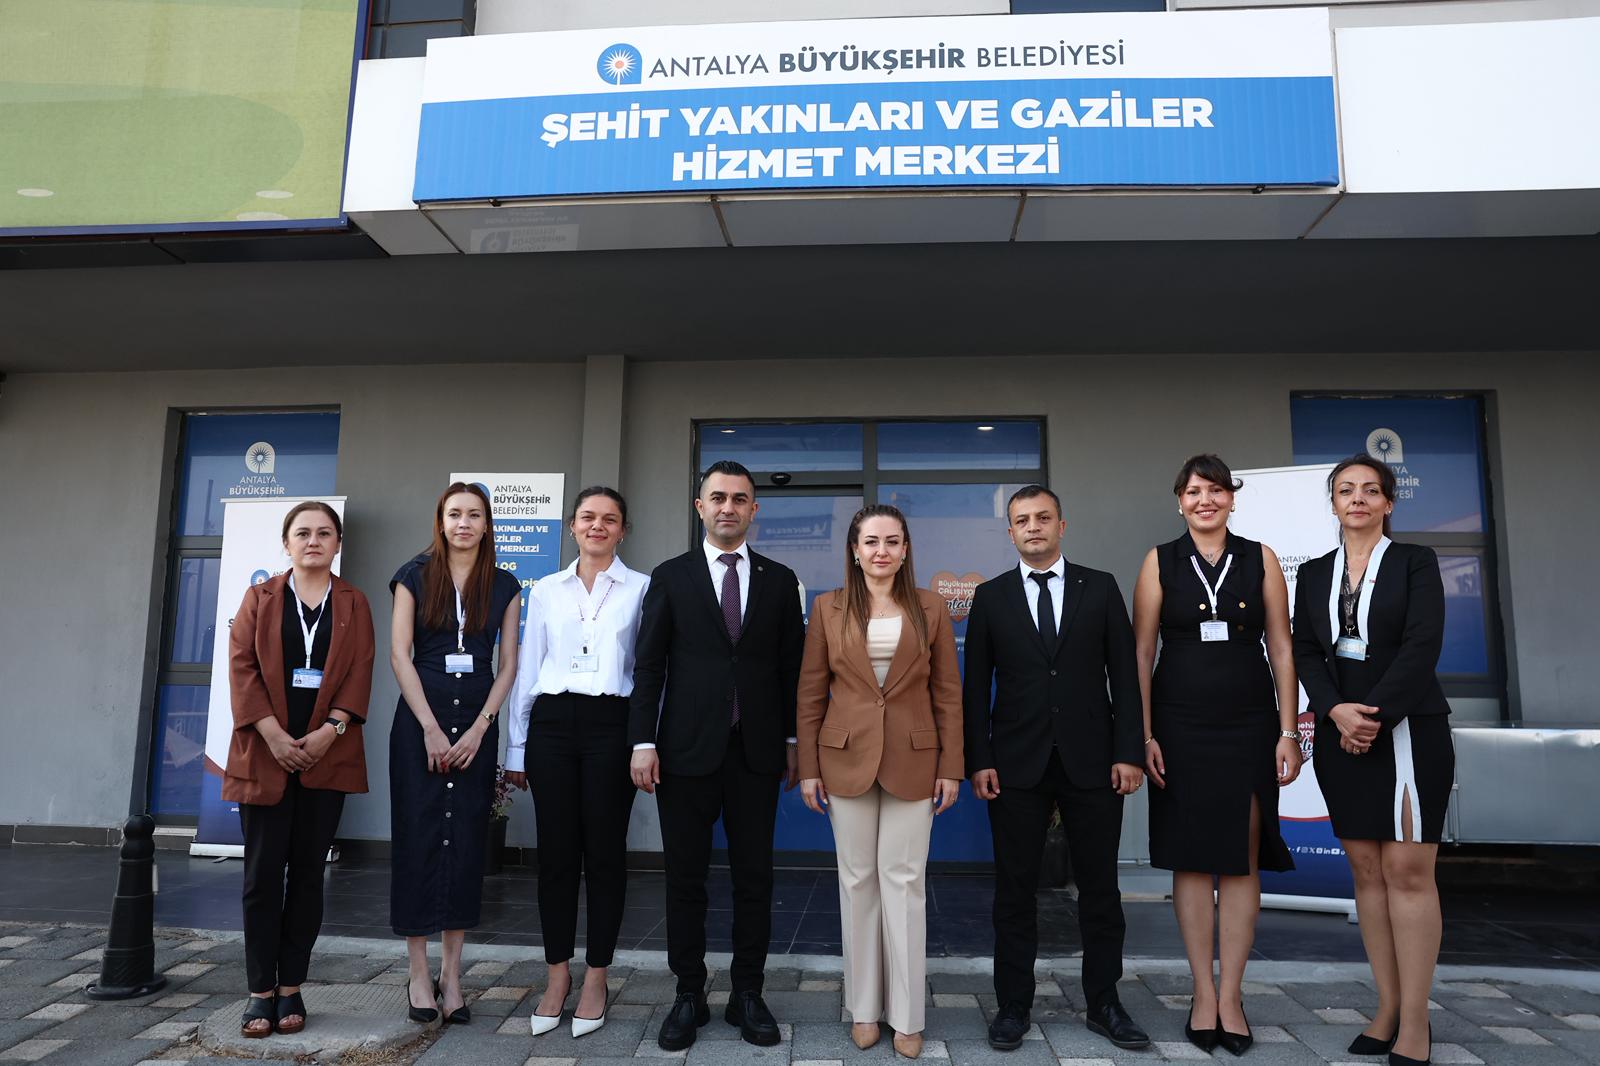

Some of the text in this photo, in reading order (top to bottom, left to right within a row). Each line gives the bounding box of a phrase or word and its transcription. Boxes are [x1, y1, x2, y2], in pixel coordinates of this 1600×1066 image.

[648, 39, 1125, 78] ANTALYA BÜYÜKŞEHİR BELEDİYESİ
[540, 91, 1215, 148] ŞEHİT YAKINLARI VE GAZİLER
[671, 136, 1061, 182] HİZMET MERKEZİ
[240, 475, 277, 484] ANTALYA
[229, 484, 285, 497] BÜYÜKŞEHİR
[494, 485, 532, 493] ANTALYA
[493, 494, 551, 505] BÜYÜKŞEHİR
[493, 505, 538, 515] BELEDİYESİ
[493, 525, 549, 533] AKINLARI VE
[494, 534, 522, 543] ZİLER
[500, 543, 540, 552] MERKEZİ
